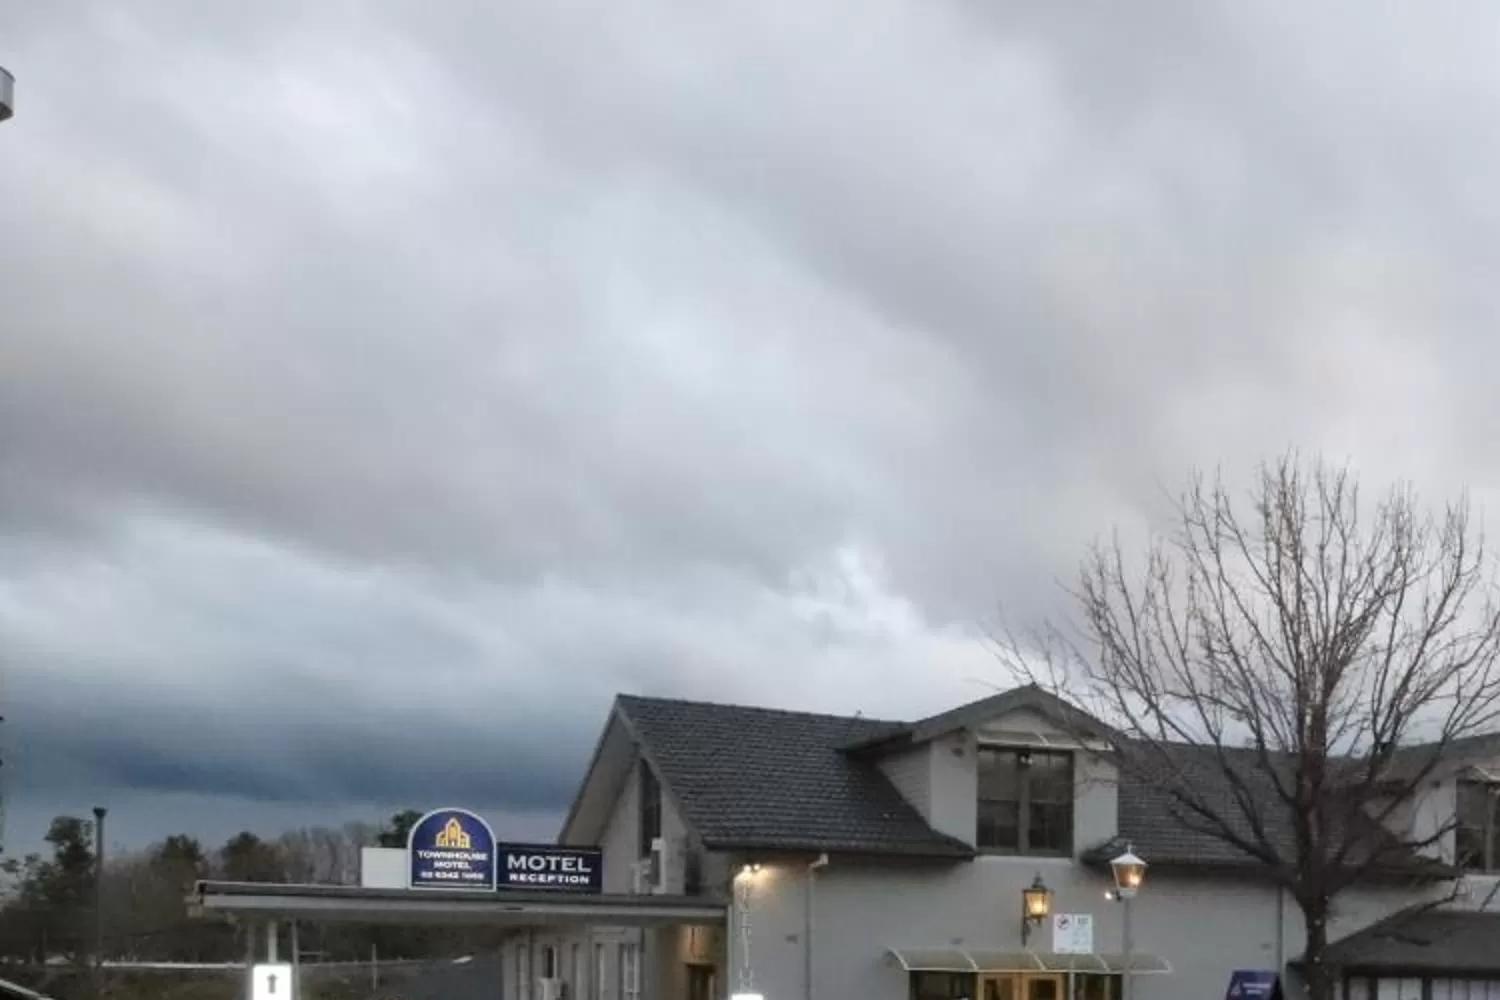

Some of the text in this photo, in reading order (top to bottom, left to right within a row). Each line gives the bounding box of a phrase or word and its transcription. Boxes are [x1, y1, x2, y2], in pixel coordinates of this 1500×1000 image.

[417, 850, 488, 861] TOWNHOUSE
[433, 860, 472, 869] MOTEL
[507, 854, 592, 873] MOTEL
[509, 873, 589, 885] RECEPTION
